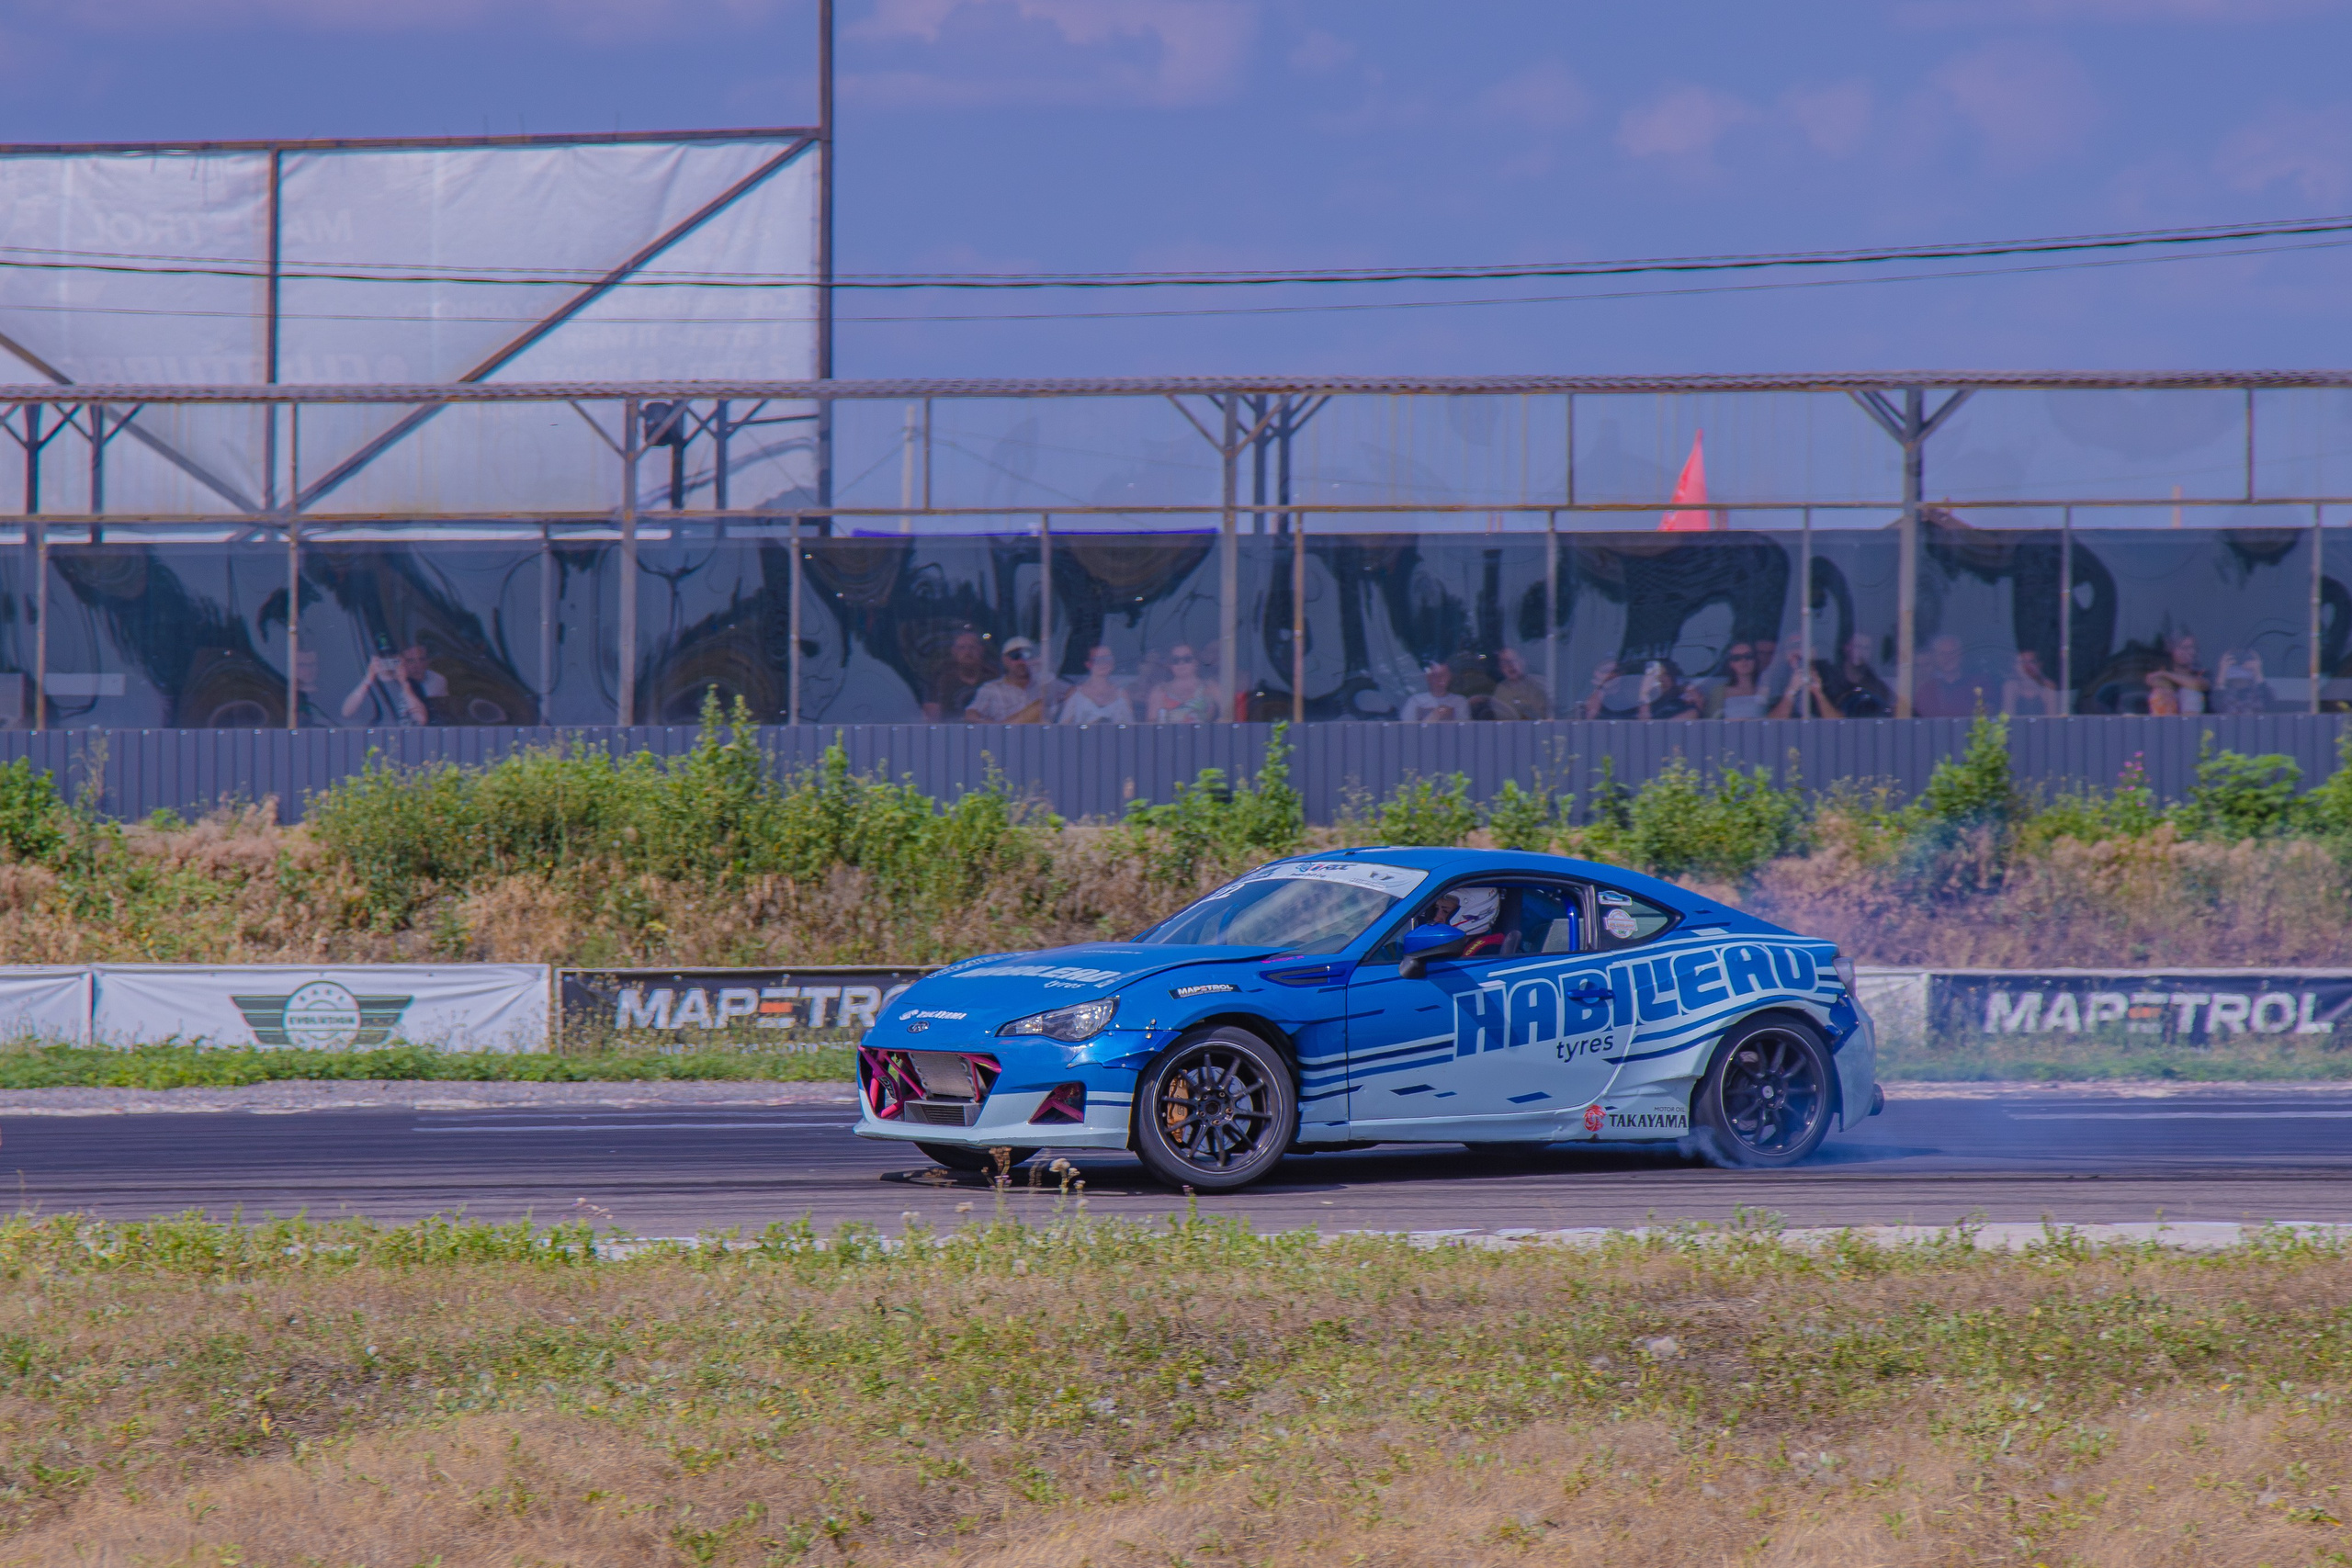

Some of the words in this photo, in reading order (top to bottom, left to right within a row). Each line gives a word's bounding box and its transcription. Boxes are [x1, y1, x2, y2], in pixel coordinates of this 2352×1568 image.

[1177, 984, 1233, 995] MAPETROL
[1454, 942, 1815, 1057] HABILEAD
[1984, 990, 2335, 1034] MAPETROL
[1556, 1034, 1614, 1063] tyres
[1609, 1113, 1688, 1128] TAKAYAMA
